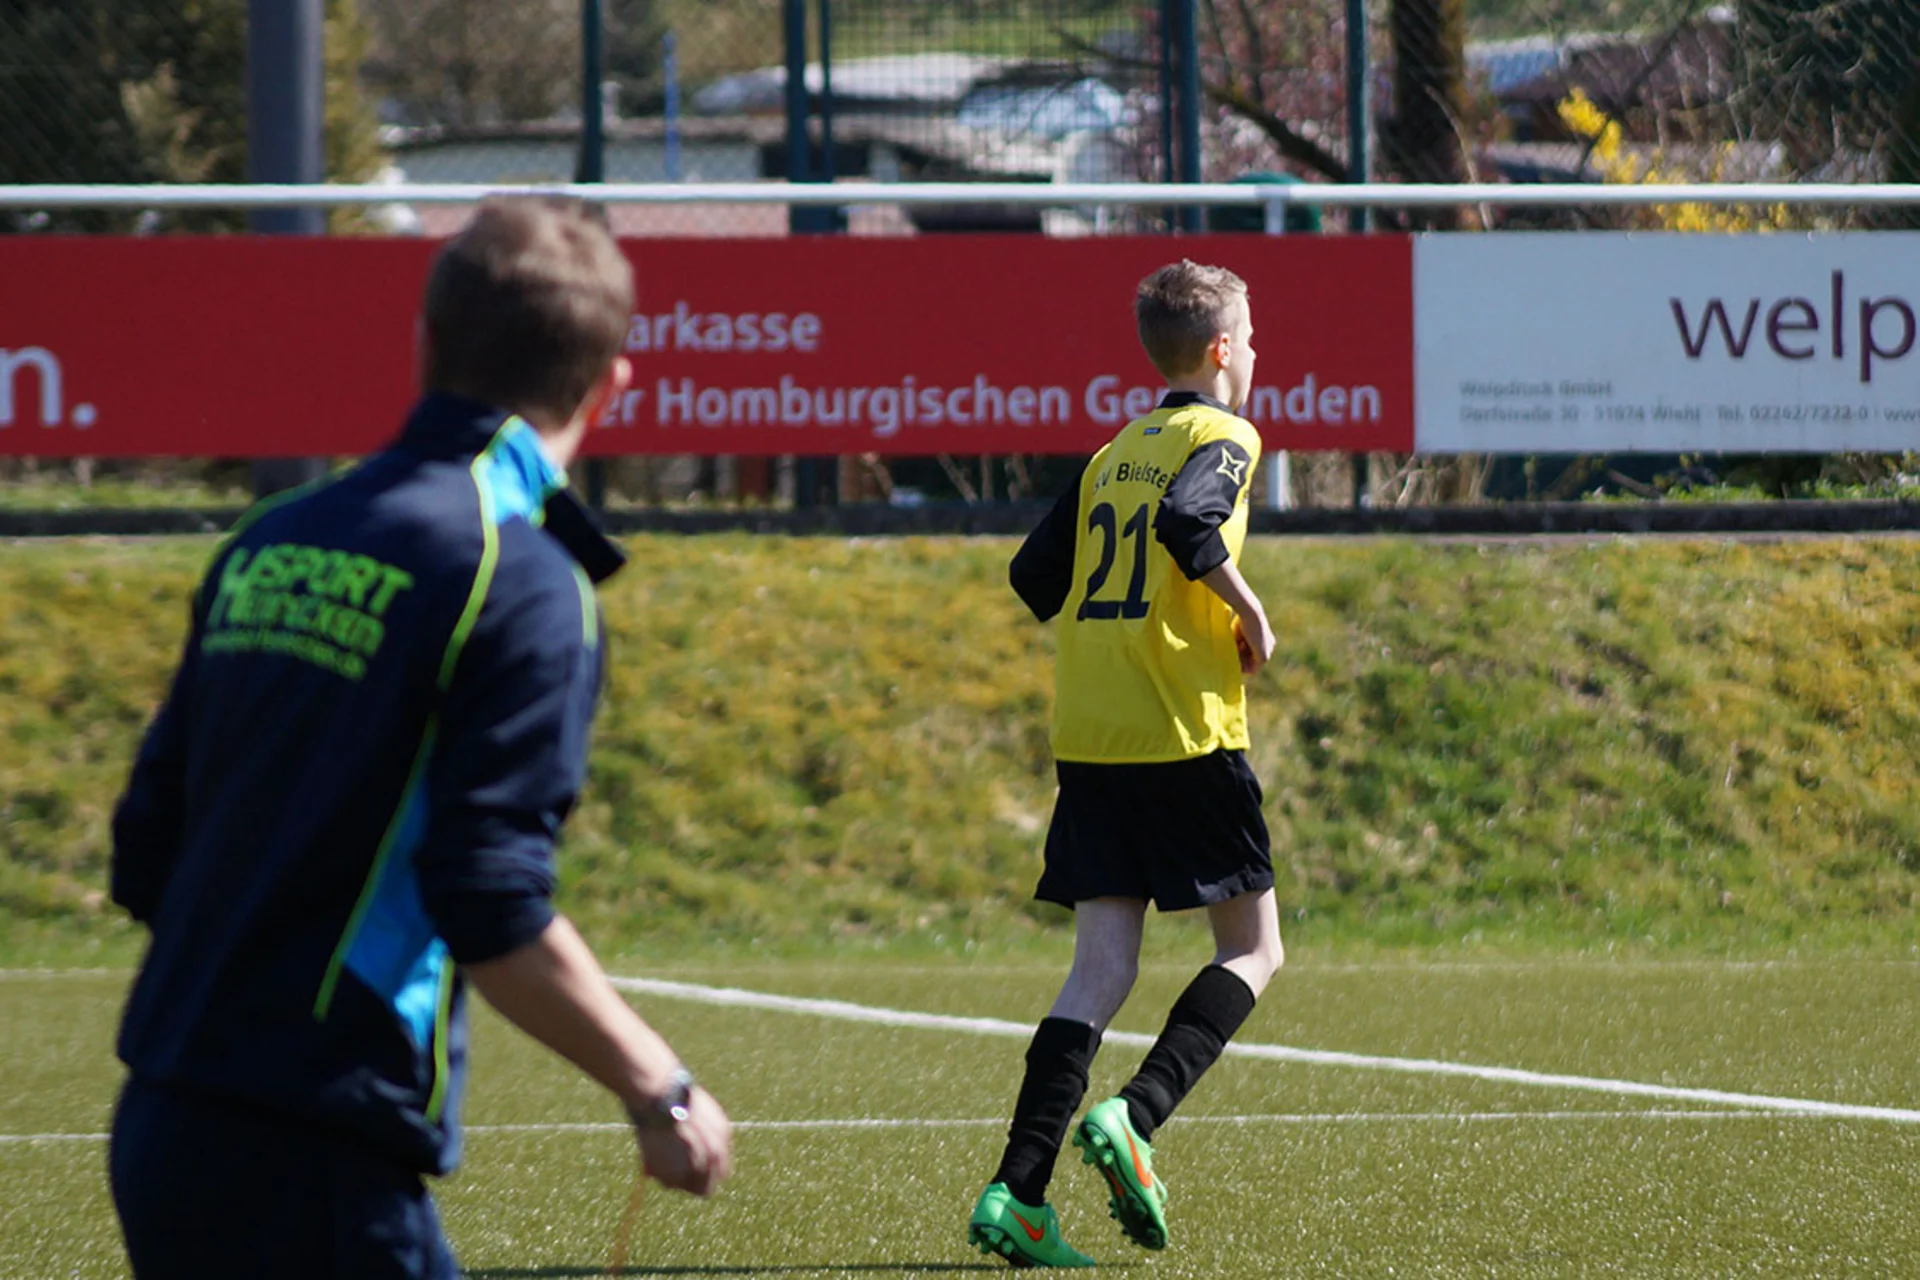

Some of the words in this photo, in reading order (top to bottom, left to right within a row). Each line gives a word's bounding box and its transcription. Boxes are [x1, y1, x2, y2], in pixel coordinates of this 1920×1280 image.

[1670, 269, 1916, 383] welp
[656, 375, 1071, 438] Homburgischen
[1085, 373, 1381, 425] Genden
[1077, 502, 1150, 621] 21
